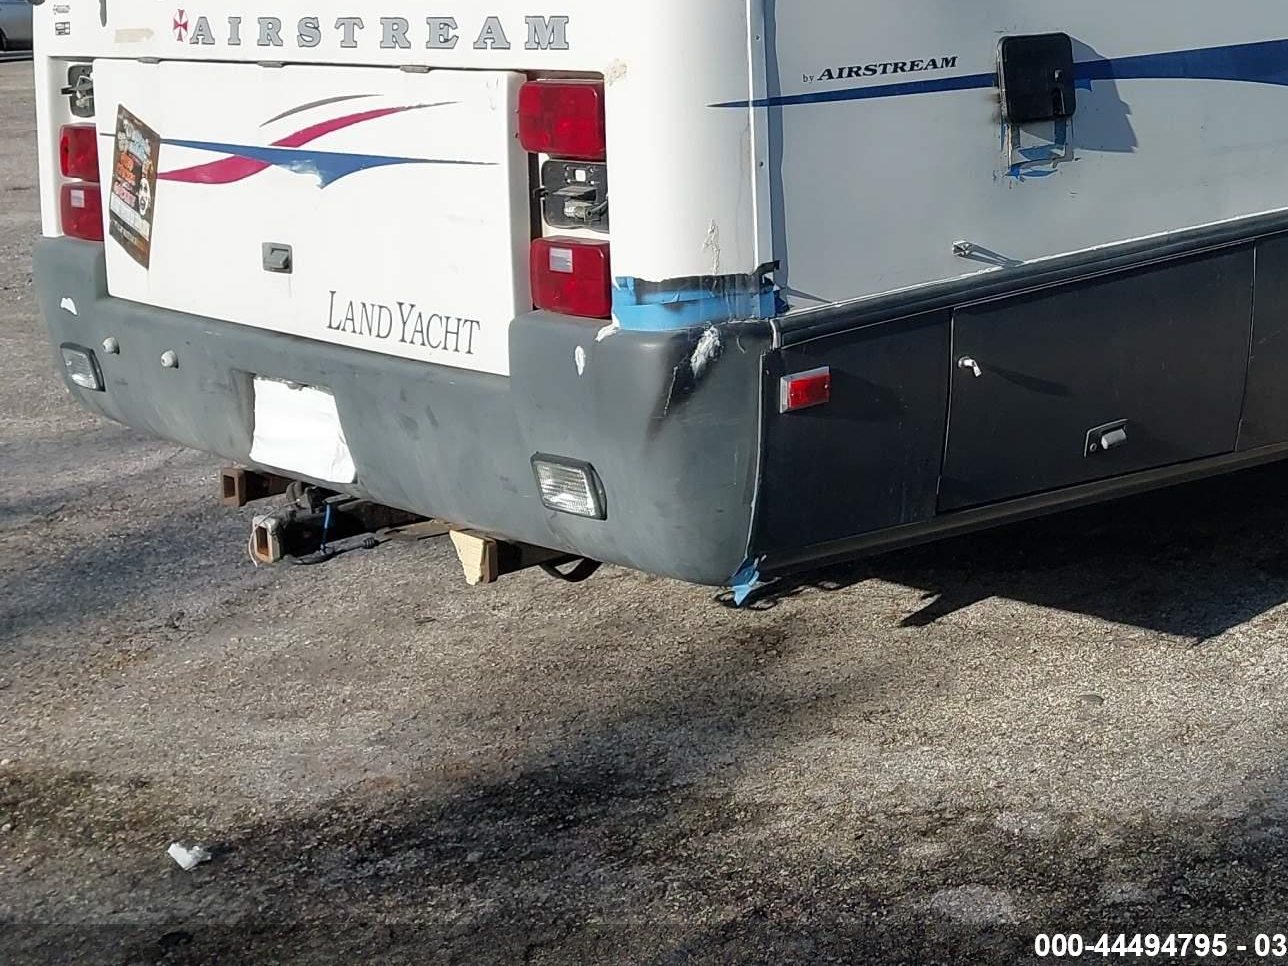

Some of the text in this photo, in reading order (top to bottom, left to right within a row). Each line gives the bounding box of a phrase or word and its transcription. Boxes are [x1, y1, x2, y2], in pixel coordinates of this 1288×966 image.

[189, 15, 570, 50] AIRSTREAM
[802, 56, 959, 83] by AIRSTREAM
